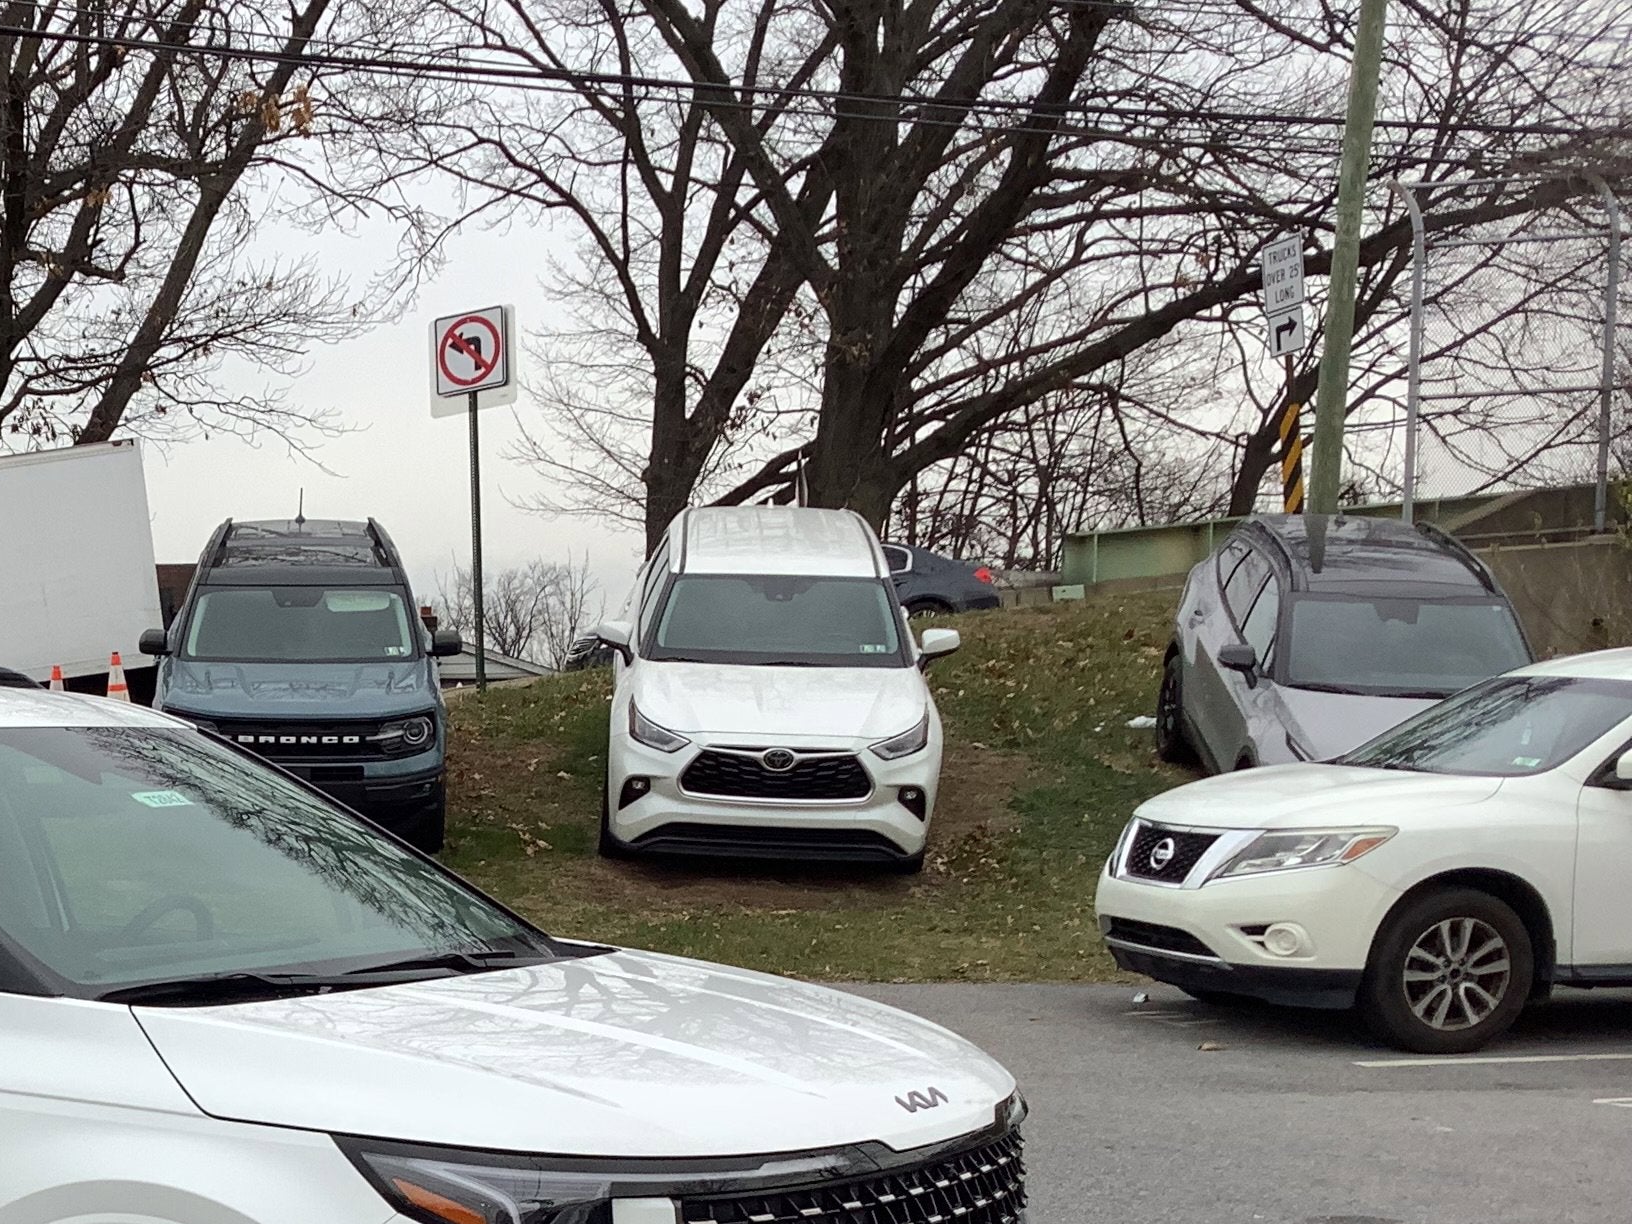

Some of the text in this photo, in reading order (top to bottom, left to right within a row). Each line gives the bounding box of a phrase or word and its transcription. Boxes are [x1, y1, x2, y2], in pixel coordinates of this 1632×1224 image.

[1269, 245, 1296, 264] TRUCKS
[1267, 268, 1285, 286] OVER
[1274, 285, 1294, 303] LONG
[237, 735, 360, 744] BRONCO
[894, 1086, 949, 1113] KIA
